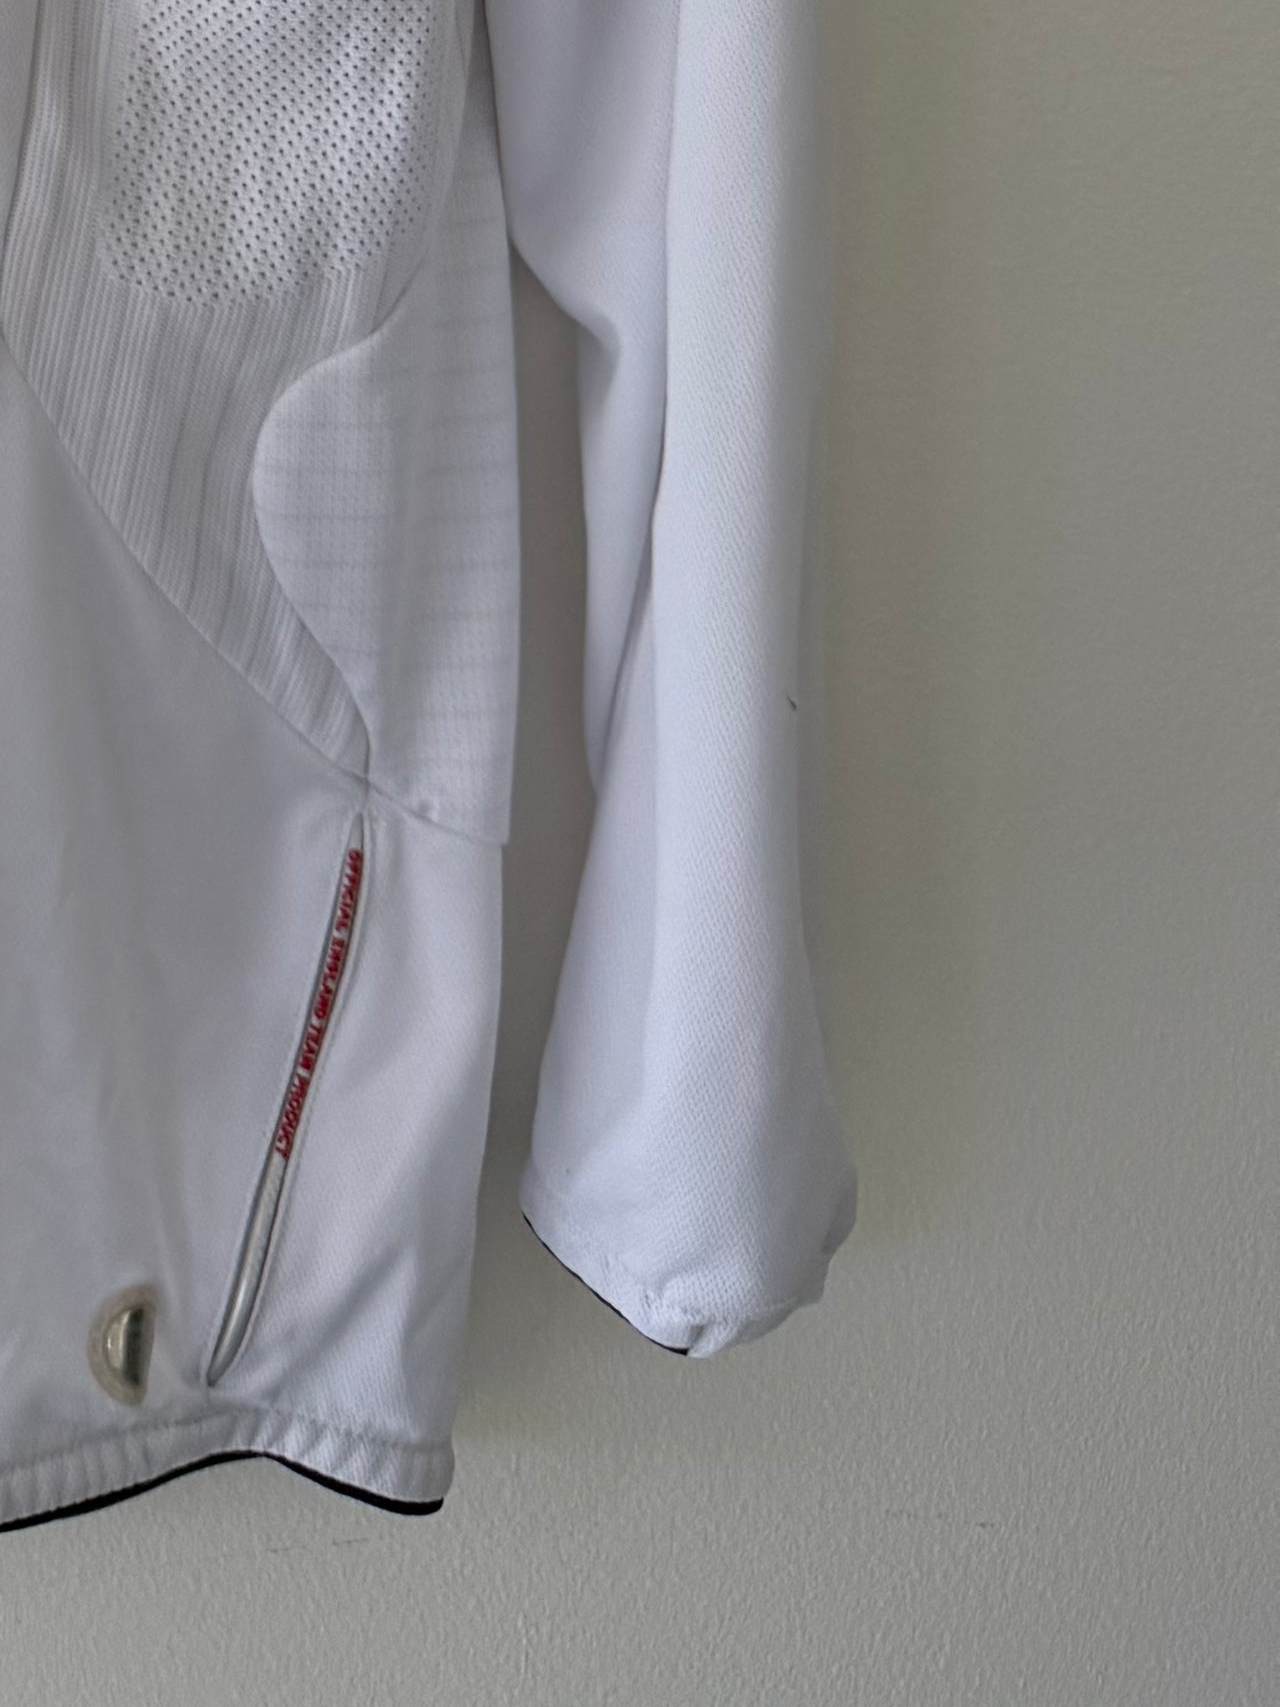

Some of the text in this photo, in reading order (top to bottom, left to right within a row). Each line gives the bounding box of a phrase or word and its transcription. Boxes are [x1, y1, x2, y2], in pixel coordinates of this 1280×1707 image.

[274, 849, 363, 1161] OFFICIAL ENGLAND TEAM PRODUCT
